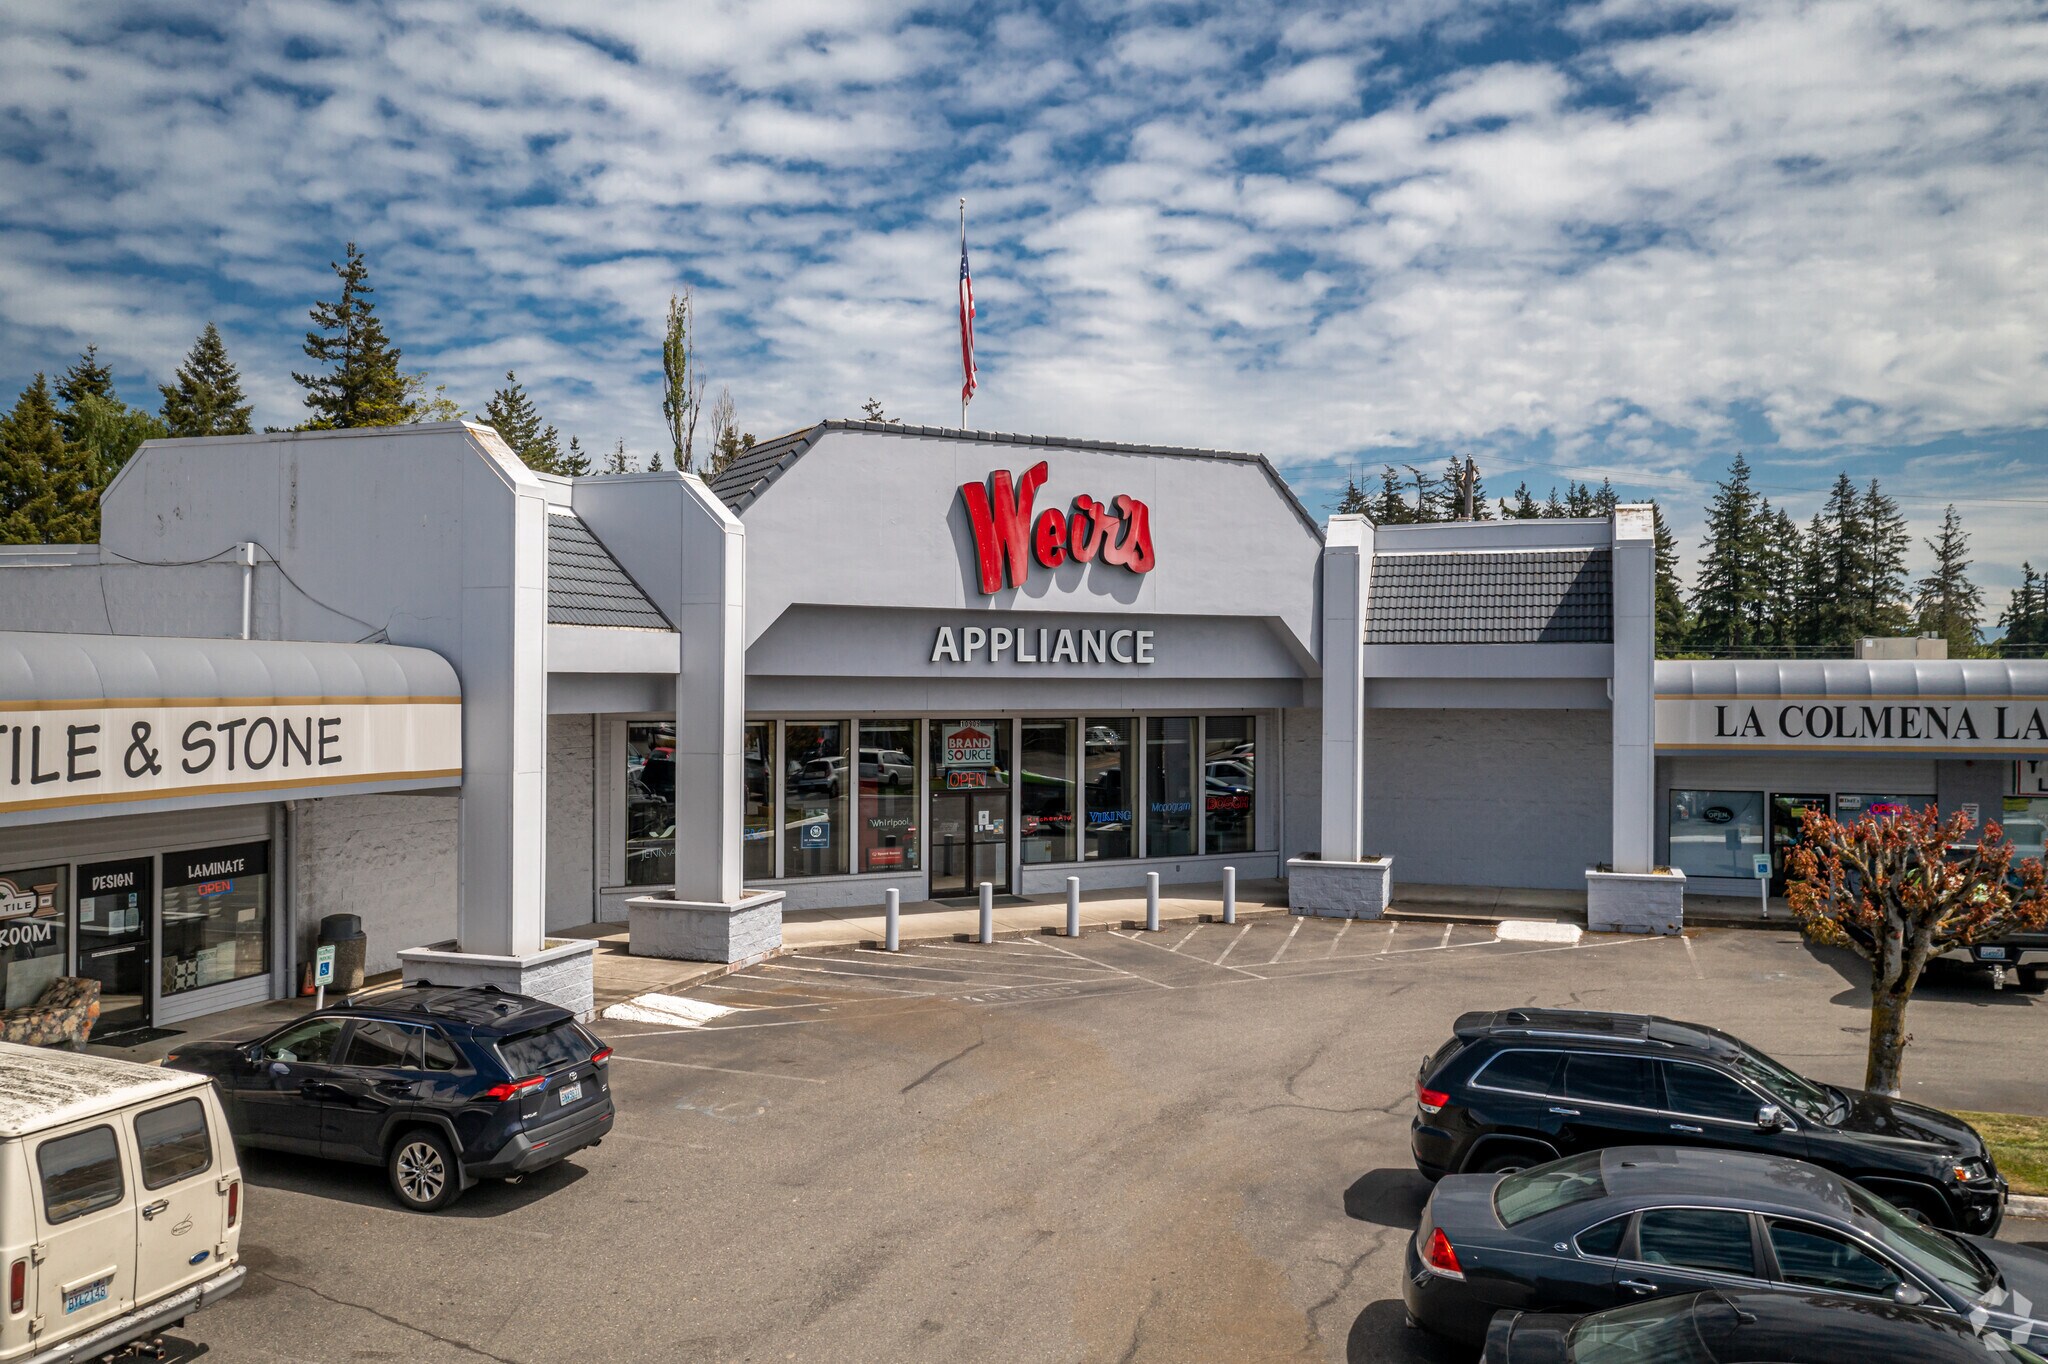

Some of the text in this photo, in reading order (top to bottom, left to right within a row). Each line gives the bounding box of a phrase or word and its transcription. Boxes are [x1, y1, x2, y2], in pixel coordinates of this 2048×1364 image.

[930, 626, 1155, 664] APPLIANCE
[1714, 706, 1766, 737] LA
[1778, 705, 1980, 740] COLMENA
[949, 738, 990, 748] BRAND
[0, 716, 342, 785] ILE & STONE
[948, 749, 992, 760] SOURCE
[949, 772, 986, 787] OPEN
[1152, 802, 1191, 813] Monogram
[1207, 797, 1248, 809] BOSCH
[1872, 804, 1902, 814] OPEN
[1089, 811, 1132, 822] VIKING
[869, 818, 909, 828] Whirlpool
[187, 858, 245, 879] LAMINATE
[92, 872, 134, 891] DESIGN
[198, 880, 231, 896] OPEN
[4, 901, 32, 912] TILE
